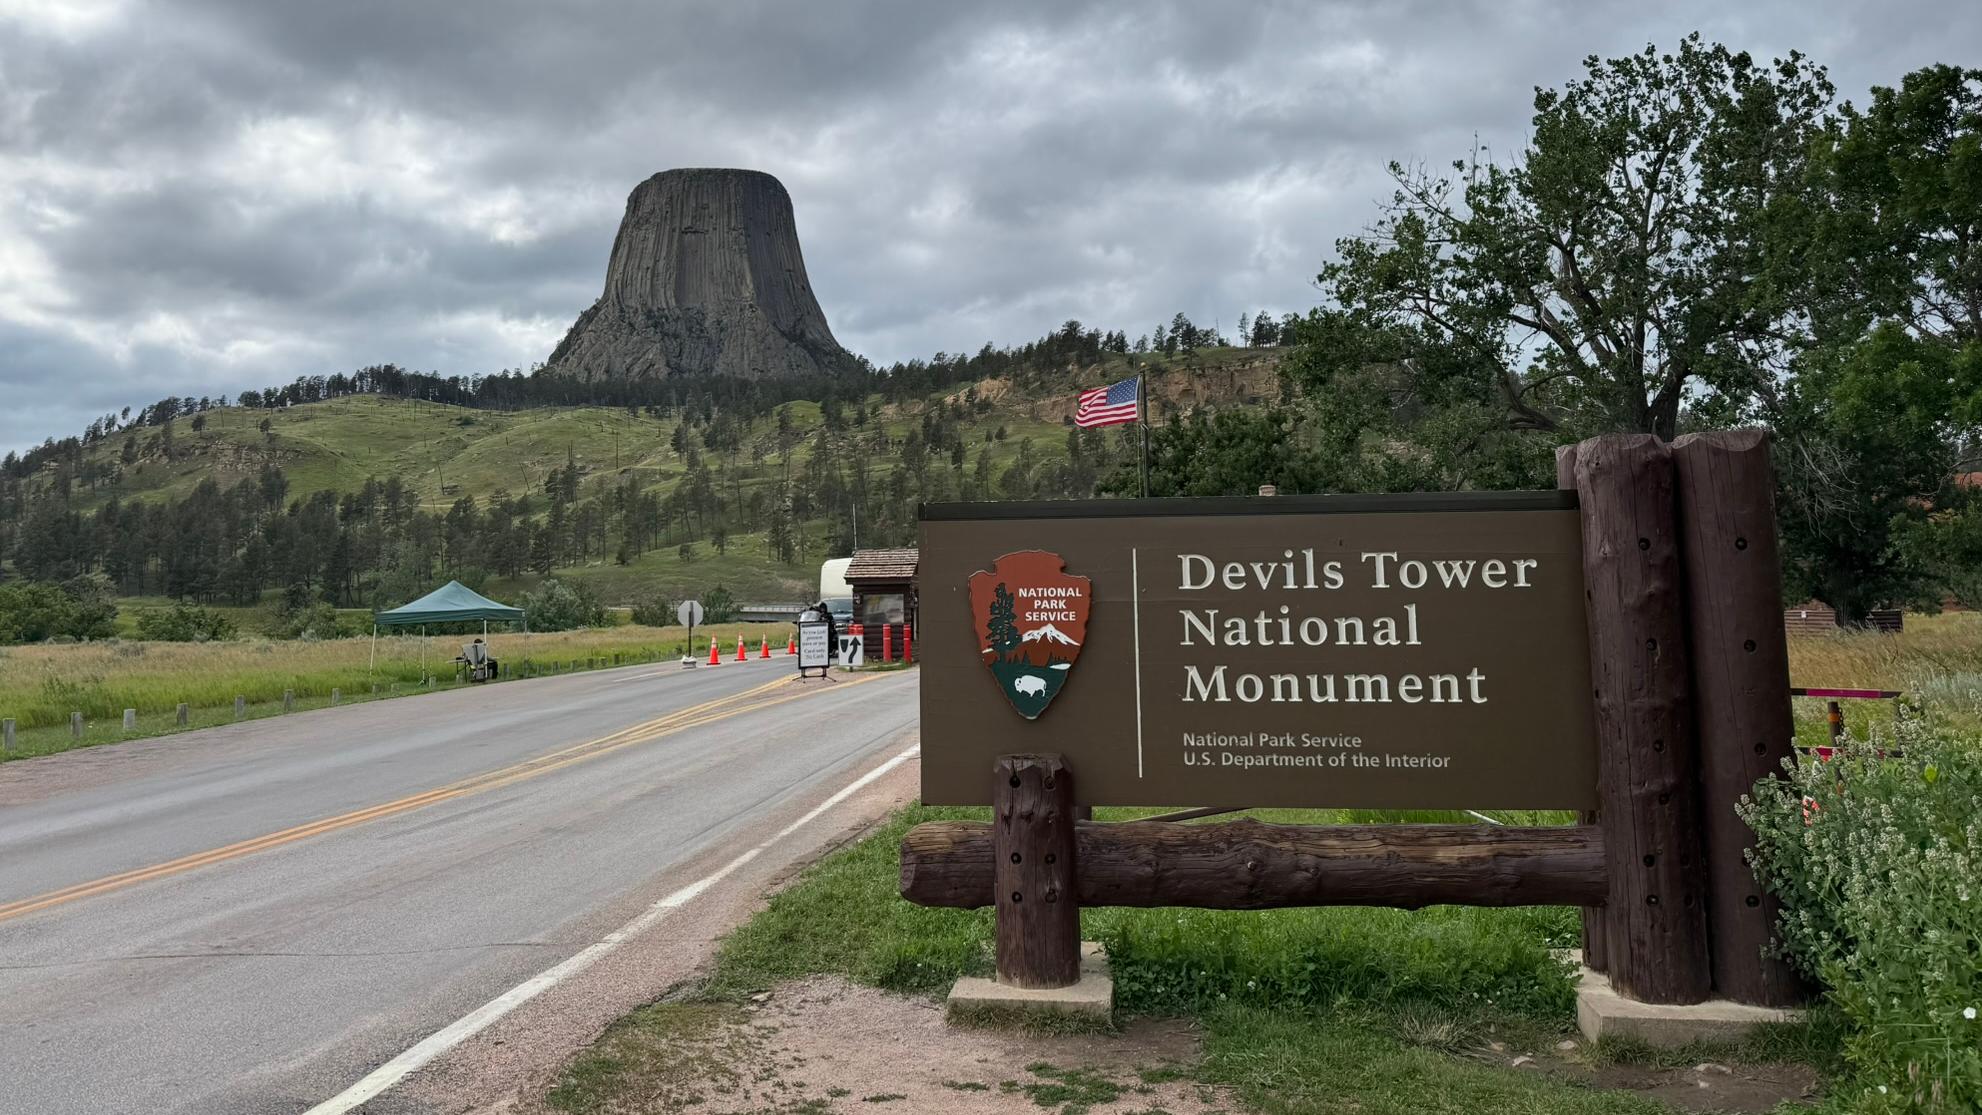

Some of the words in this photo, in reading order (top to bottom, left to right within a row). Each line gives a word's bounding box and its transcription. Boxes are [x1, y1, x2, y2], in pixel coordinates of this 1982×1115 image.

[1177, 549, 1344, 590] Devils
[1361, 551, 1538, 589] Tower
[1018, 587, 1082, 597] NATIONAL
[1034, 599, 1067, 609] PARK
[1025, 611, 1076, 622] SERVICE
[1179, 603, 1422, 646] National
[1182, 665, 1488, 703] Monument
[1183, 732, 1253, 747] National
[1259, 733, 1296, 747] Park
[1301, 733, 1362, 748] Service
[1184, 752, 1216, 766] U.S.
[1221, 752, 1324, 769] Department
[1328, 752, 1347, 767] of
[1351, 753, 1380, 767] the
[1385, 753, 1451, 768] Interior
